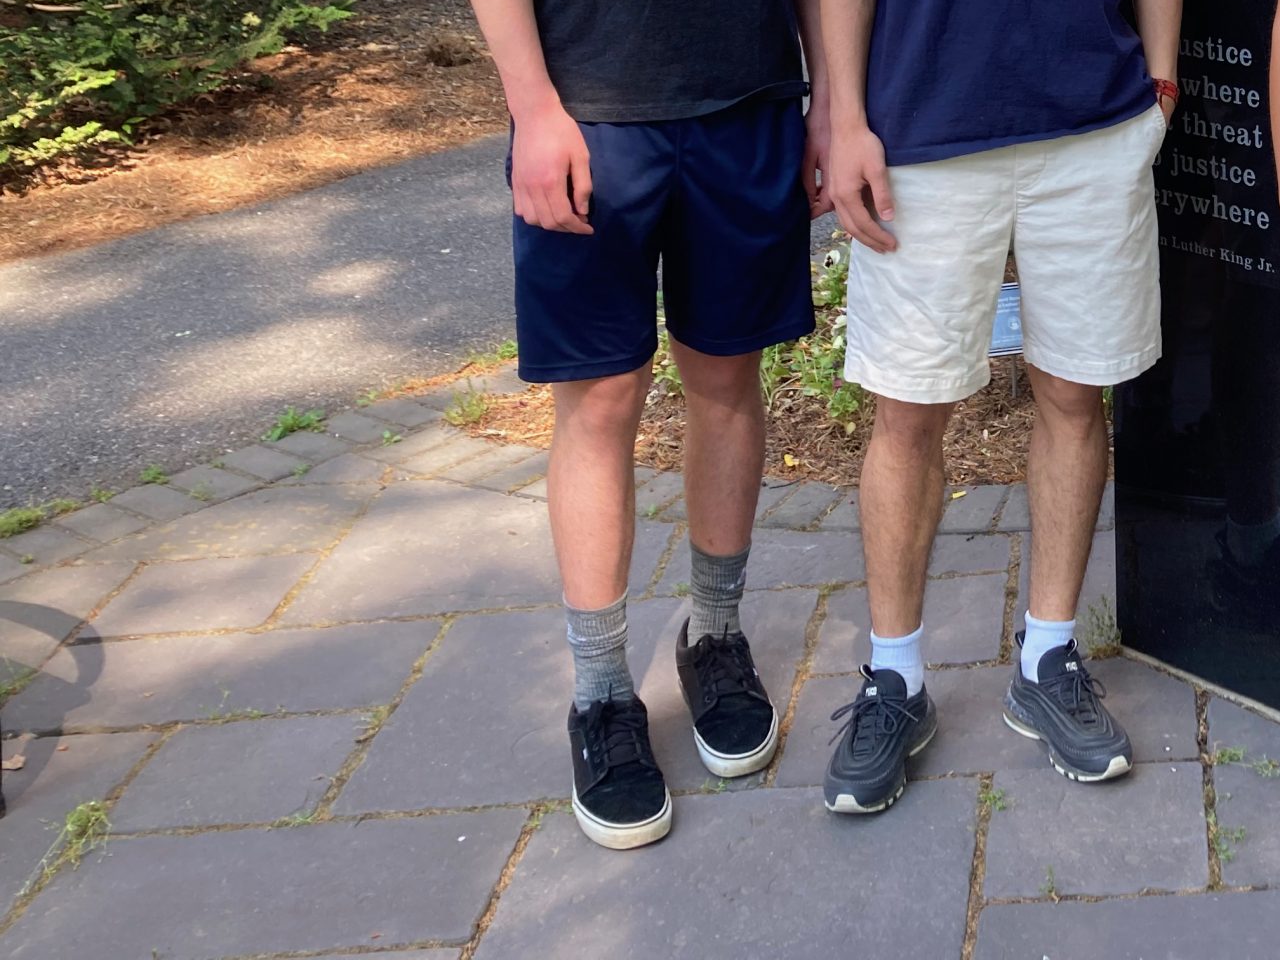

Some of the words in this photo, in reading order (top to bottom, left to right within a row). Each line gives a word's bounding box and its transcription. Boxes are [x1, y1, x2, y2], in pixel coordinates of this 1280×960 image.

[1182, 112, 1263, 149] threat
[1170, 147, 1257, 187] justice
[1171, 235, 1217, 258] Luther
[1219, 248, 1254, 271] King
[1257, 257, 1276, 274] Jr.
